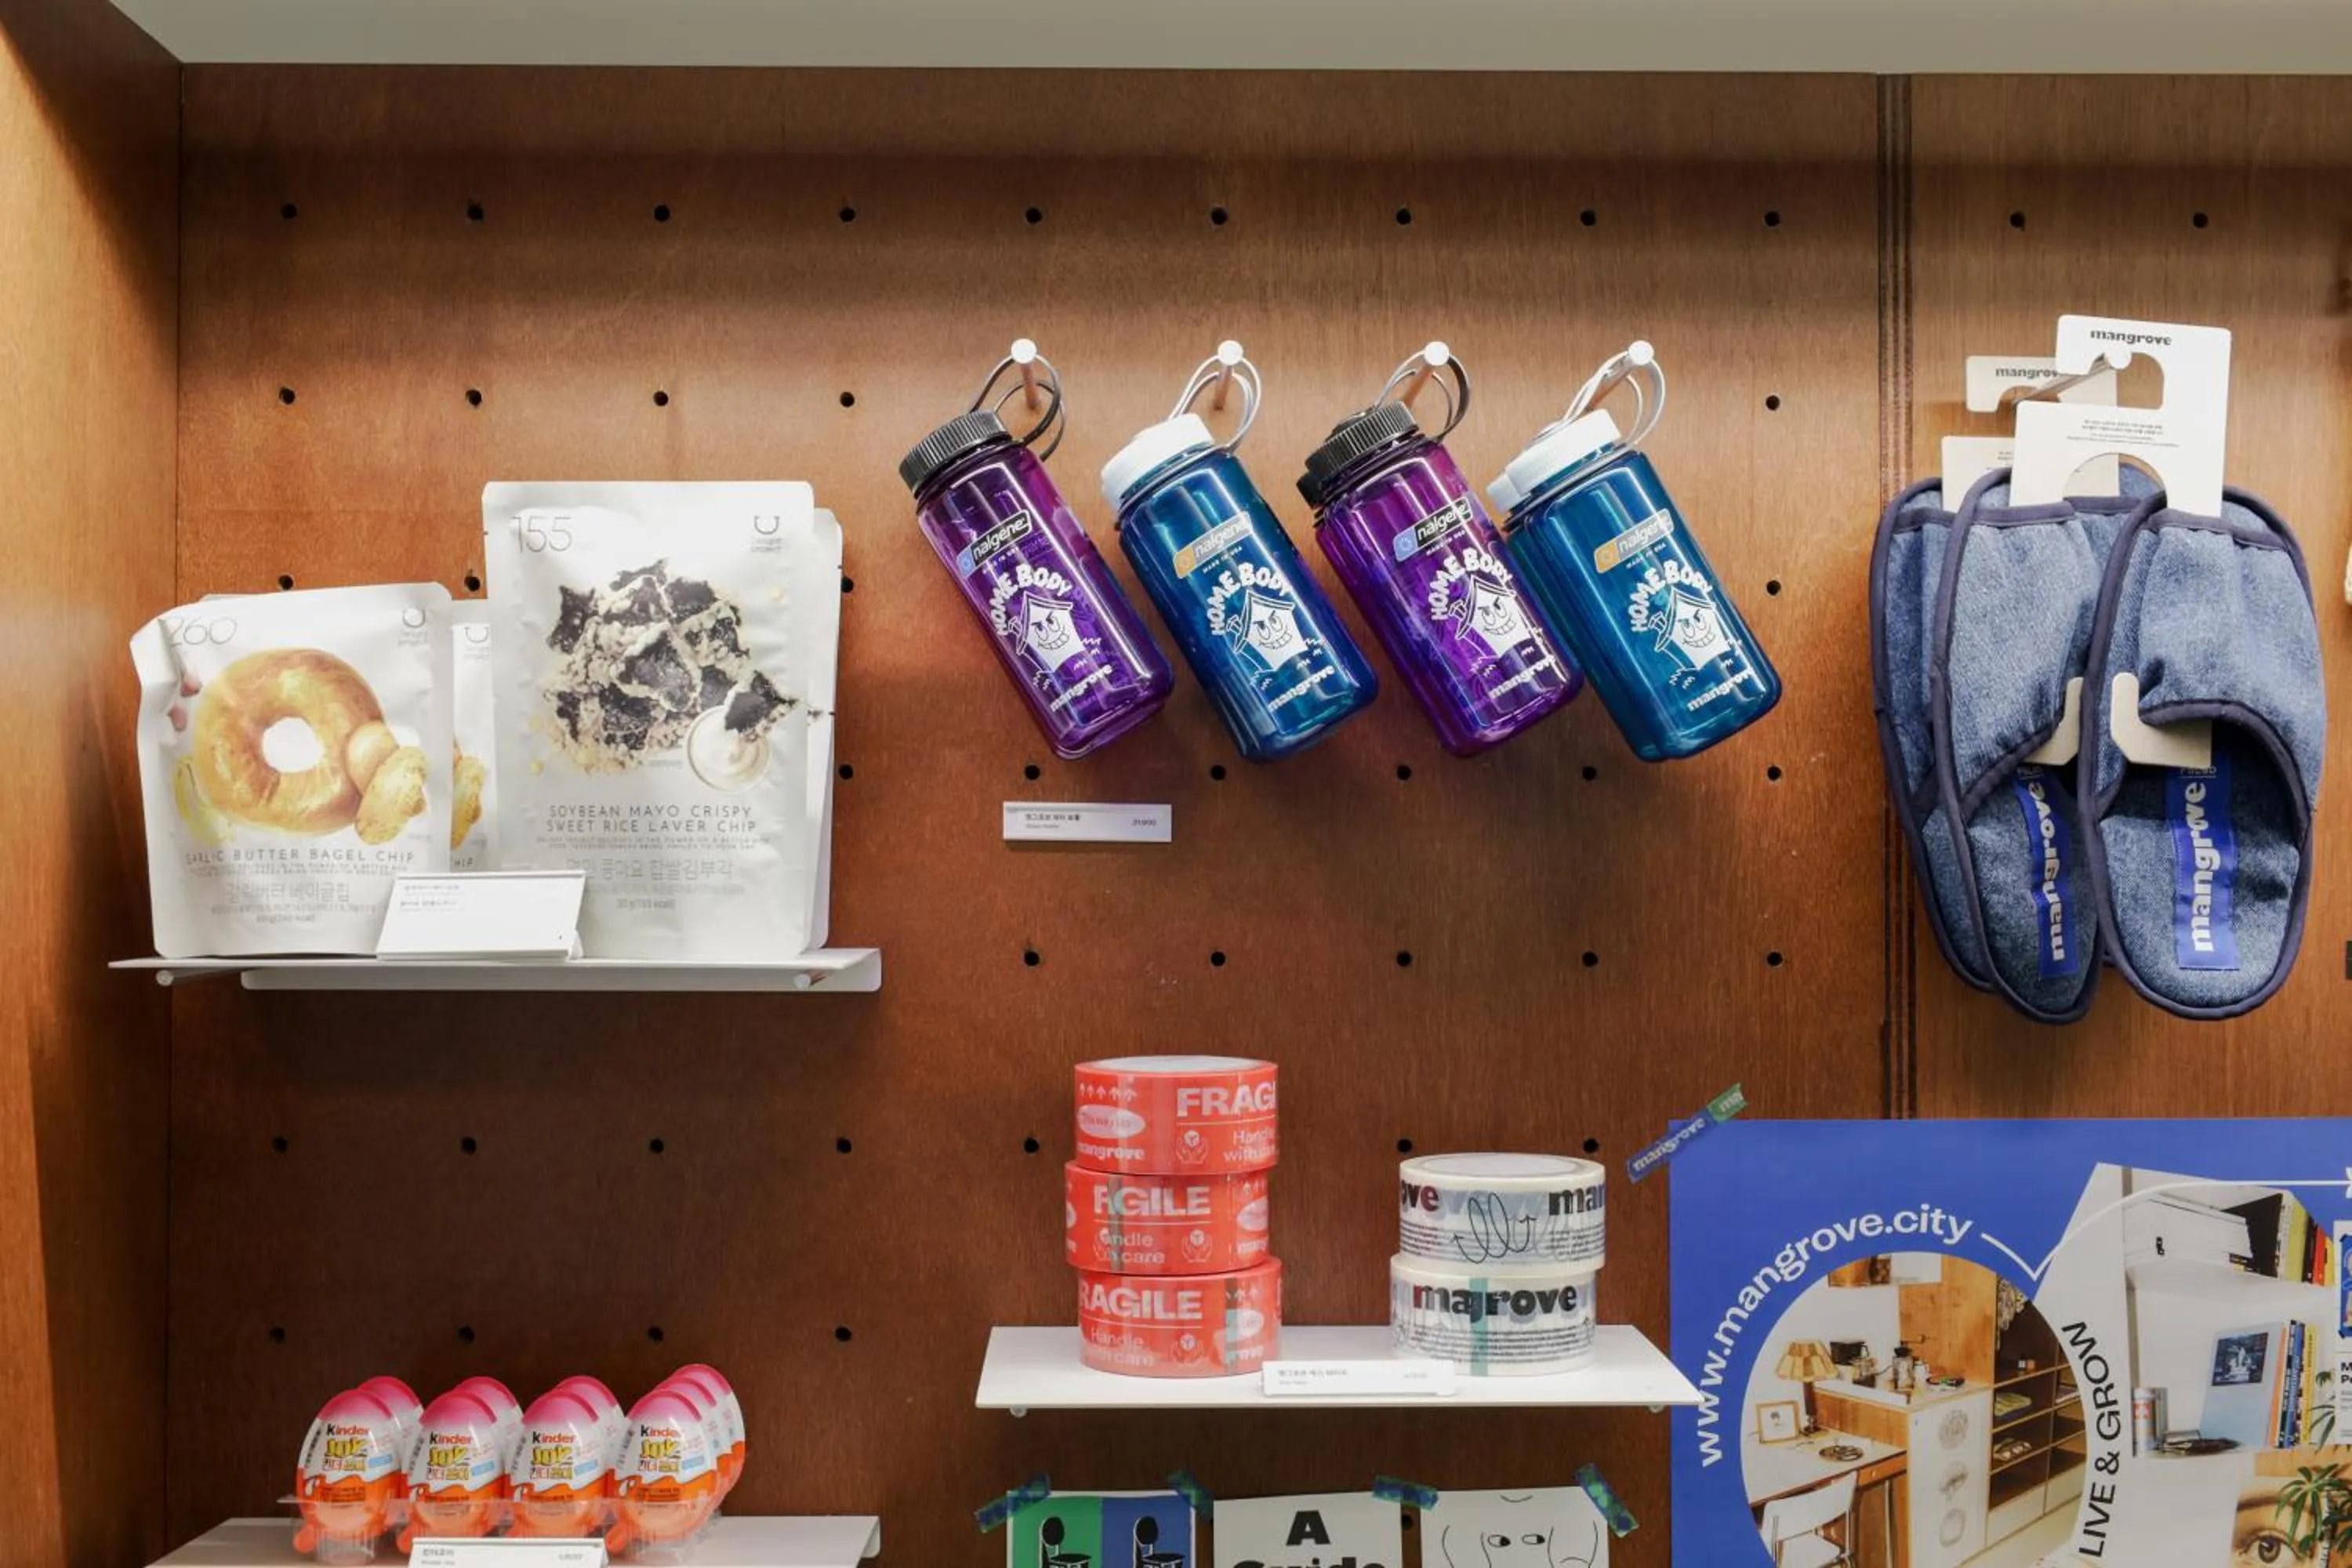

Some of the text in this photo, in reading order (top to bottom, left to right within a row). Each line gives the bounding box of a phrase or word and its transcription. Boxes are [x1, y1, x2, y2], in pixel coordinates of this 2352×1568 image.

[2090, 328, 2172, 347] mangrove
[1995, 366, 2058, 380] mangrov
[511, 516, 573, 553] 155
[973, 517, 1028, 561] nalgene
[1194, 517, 1251, 558] nalgene
[1015, 564, 1073, 596] BODY
[1207, 562, 1294, 635] HOME BODY
[1428, 556, 1465, 621] HOME
[1628, 567, 1666, 632] HOME
[170, 615, 238, 647] 260
[1050, 664, 1113, 712] mangrove
[1268, 666, 1334, 712] mangrove
[1490, 655, 1555, 699] mangrov
[1687, 666, 1752, 712] mangrov
[546, 820, 757, 833] SWEET RICE LAVER CHIP
[549, 804, 752, 818] SOYBEAN MAYO CRISPY
[233, 848, 299, 862] BUTTER
[310, 848, 366, 862] BAGEL
[376, 849, 415, 862] CHIP
[448, 857, 474, 867] HIP
[2028, 782, 2066, 963] mangrove
[1632, 1117, 1707, 1171] mangrove
[1079, 1278, 1203, 1320] RAGILE
[1697, 1203, 1974, 1468] www.mangrove.city
[2061, 1322, 2121, 1558] LIVE & GROW
[1287, 1510, 1331, 1546] A
